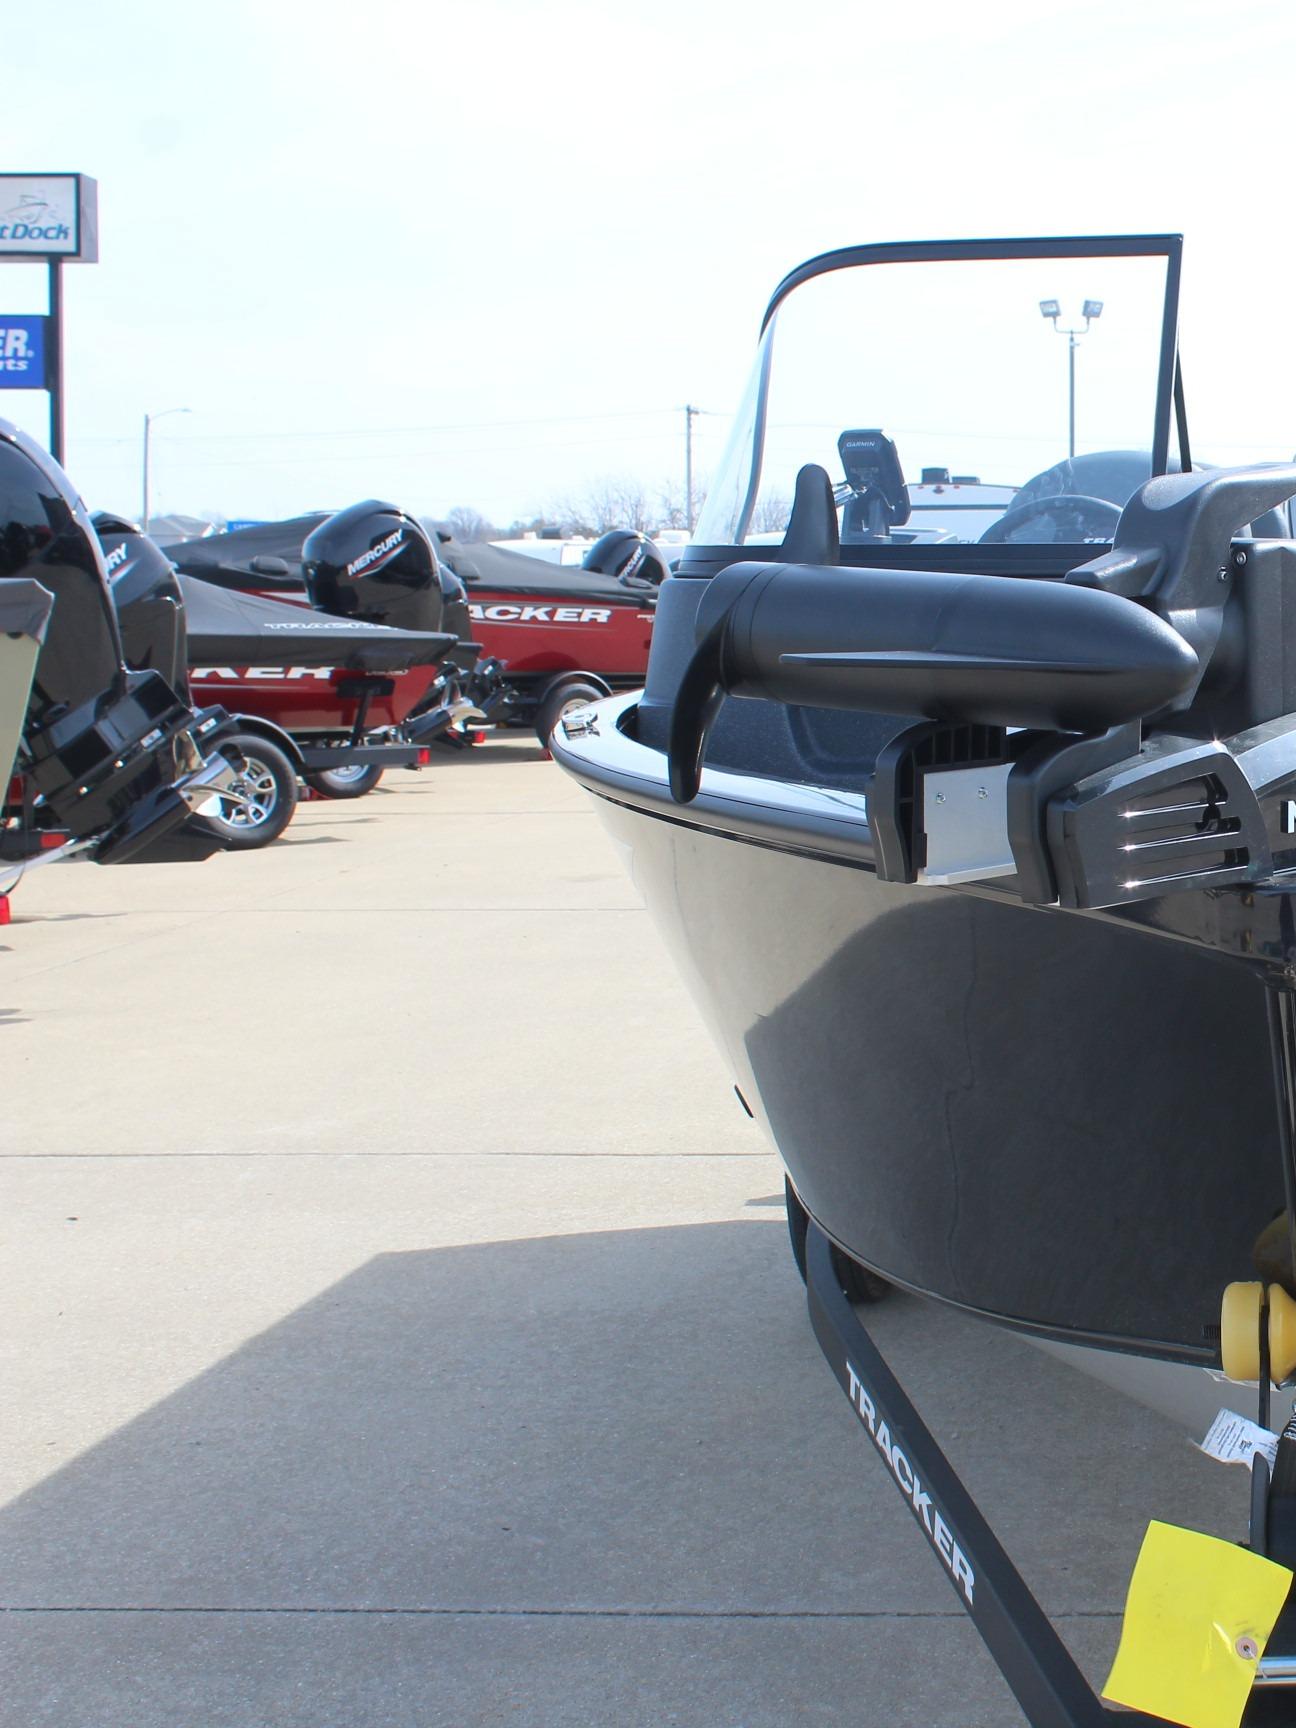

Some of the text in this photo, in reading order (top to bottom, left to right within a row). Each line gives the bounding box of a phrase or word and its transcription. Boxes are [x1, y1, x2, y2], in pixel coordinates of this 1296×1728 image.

[10, 223, 71, 240] Dock
[0, 328, 29, 358] R
[104, 542, 127, 573] RY
[346, 528, 403, 577] MERCURY
[846, 1361, 975, 1606] TRACKER
